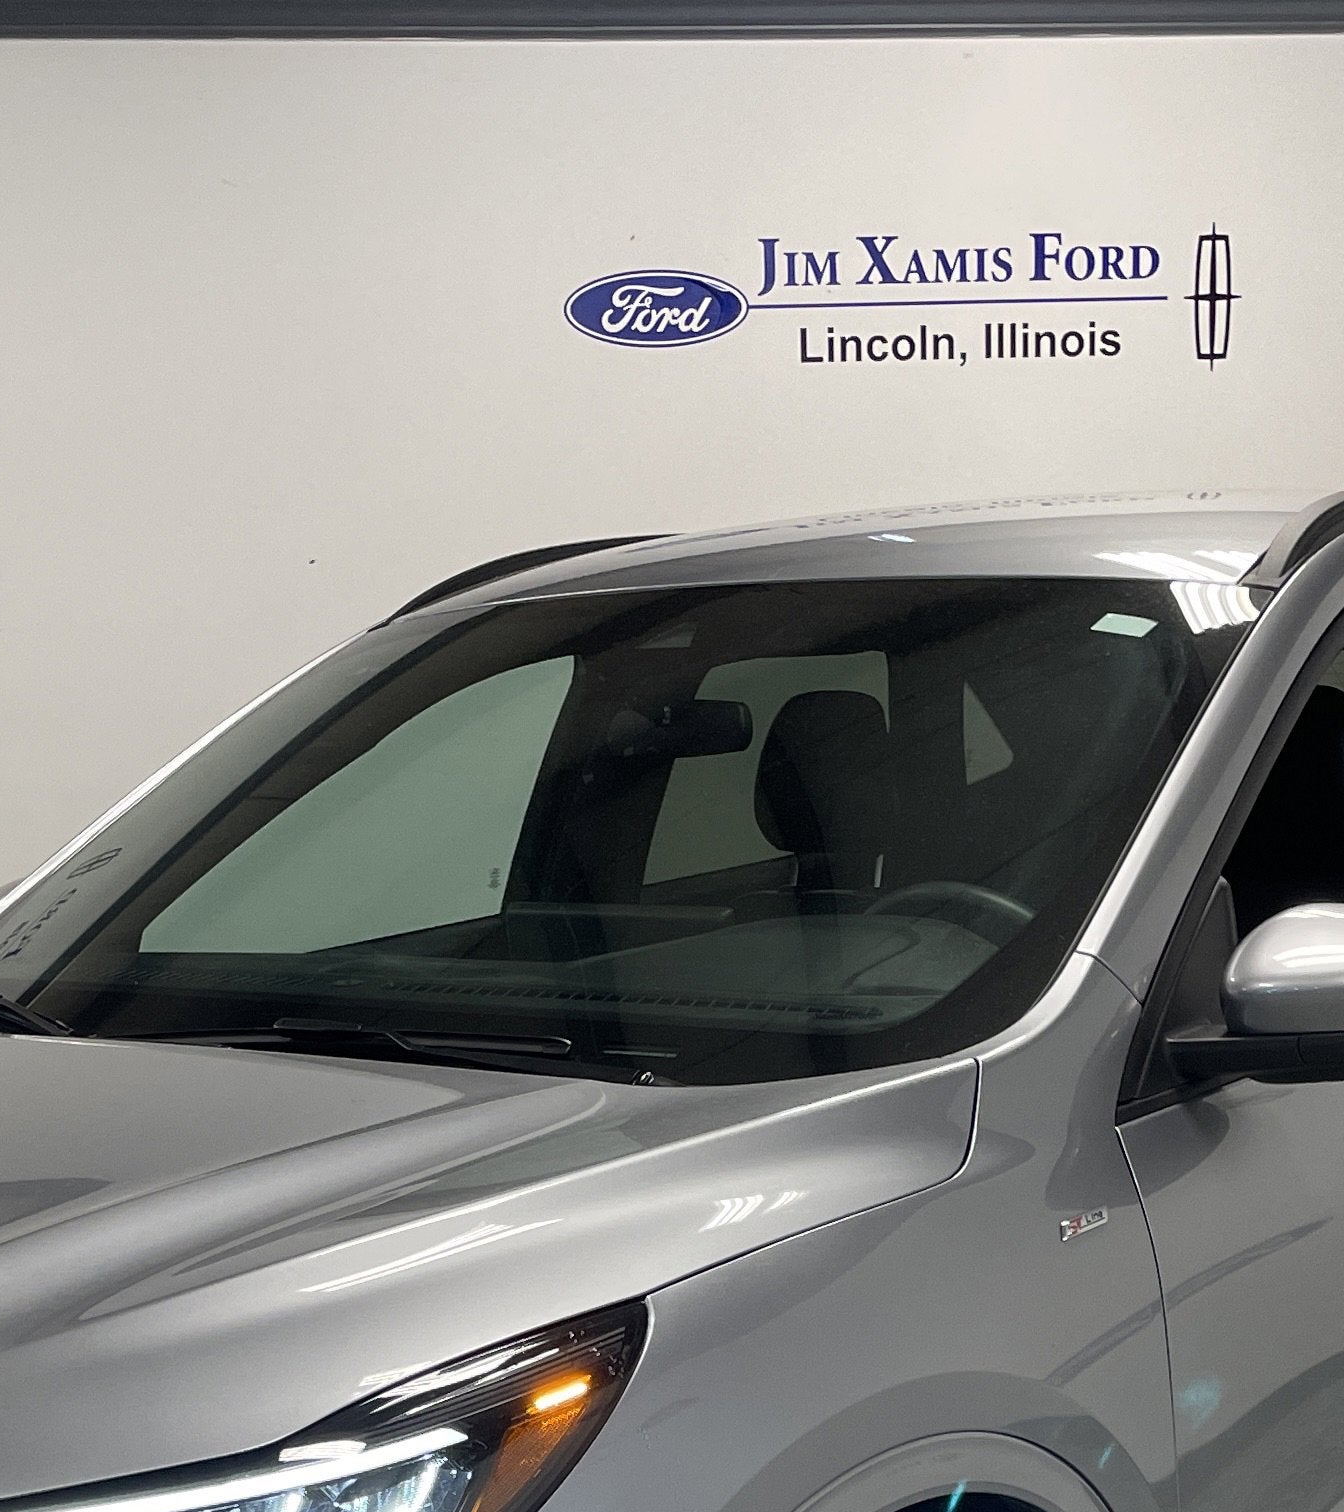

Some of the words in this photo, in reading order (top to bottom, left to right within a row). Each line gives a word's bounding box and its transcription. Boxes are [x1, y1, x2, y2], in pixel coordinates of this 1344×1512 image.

[756, 237, 841, 297] JIM
[855, 235, 1014, 286] XAMIS
[1029, 232, 1161, 282] FORD
[601, 284, 712, 334] Ford
[798, 323, 968, 368] Lincoln,
[984, 321, 1122, 360] Illinois
